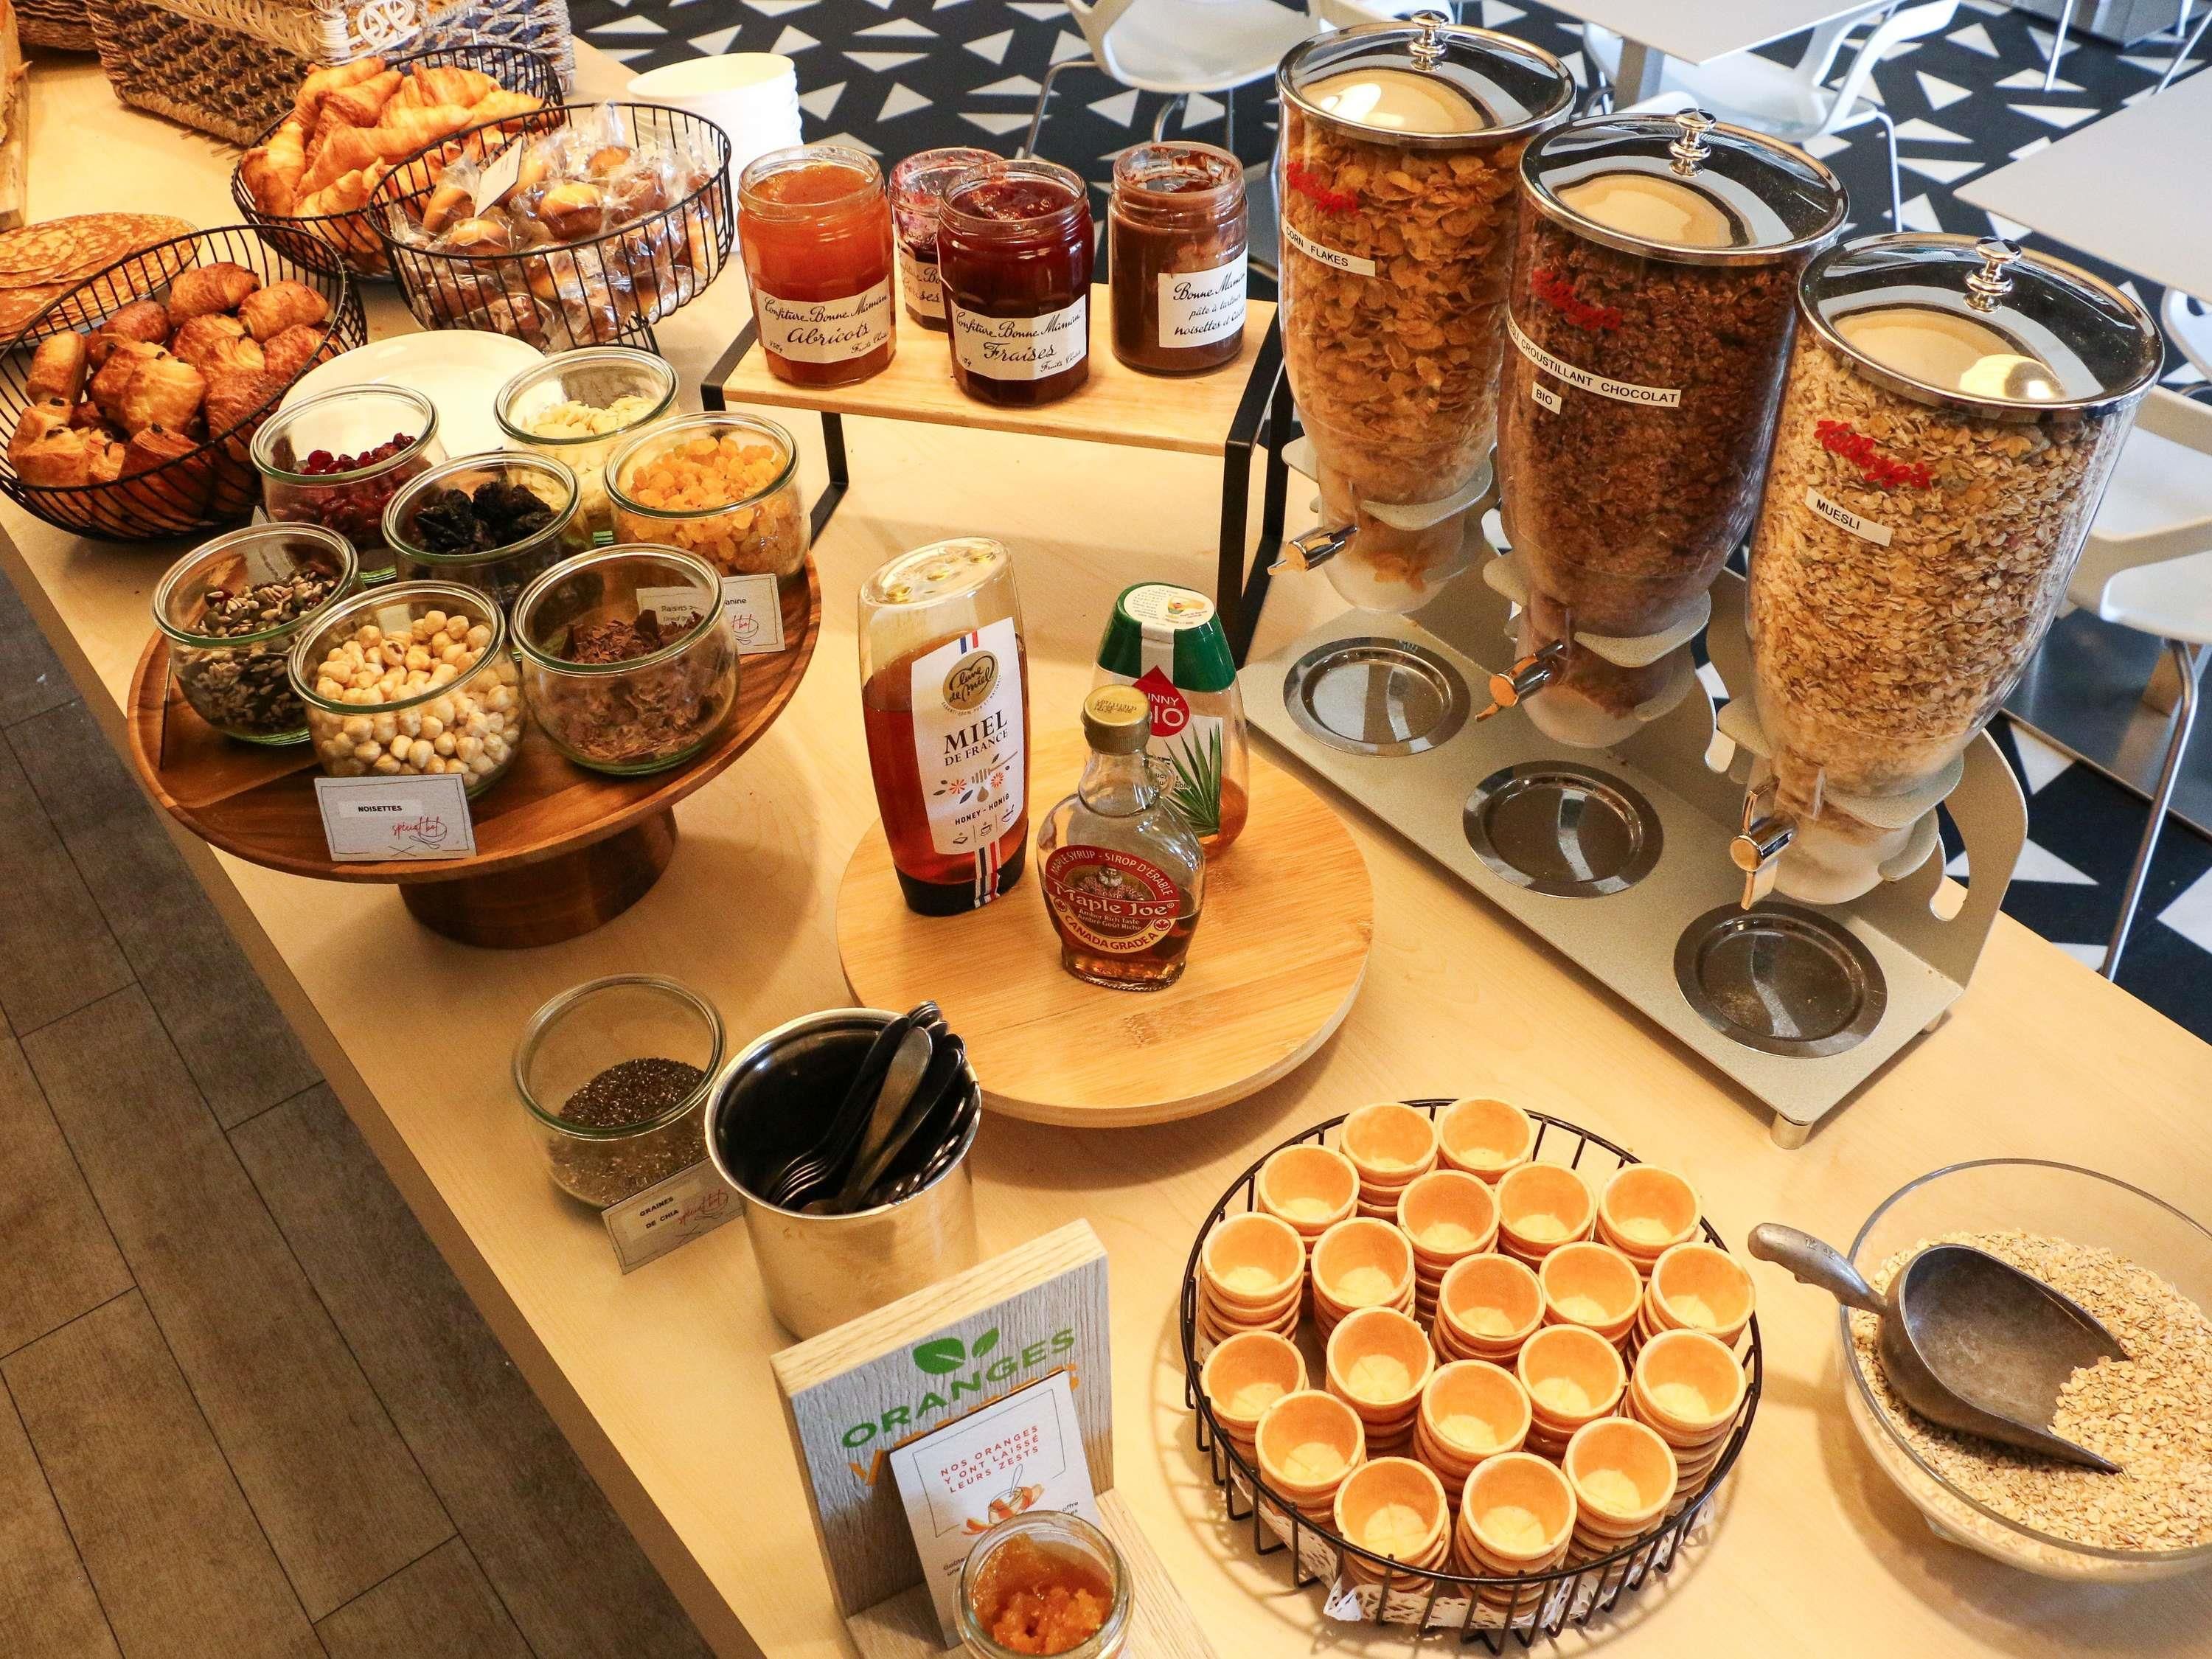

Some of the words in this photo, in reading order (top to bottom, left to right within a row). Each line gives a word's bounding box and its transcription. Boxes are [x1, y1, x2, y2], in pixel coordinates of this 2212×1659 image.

[1286, 226, 1304, 248] CORN
[1310, 246, 1349, 267] FLAKES
[1174, 282, 1214, 301] Bonne
[765, 296, 808, 321] Confiture
[810, 305, 849, 323] Bonne
[851, 295, 888, 318] Maman
[956, 310, 997, 338] Confiture
[998, 321, 1040, 338] Bonne
[1041, 311, 1081, 335] Maman
[1189, 307, 1210, 320] pâte
[1175, 320, 1221, 335] noisettes
[984, 341, 1057, 362] Fraises
[1521, 339, 1593, 386] CROUSTILLANT
[1601, 382, 1677, 403] CHOCOLAT
[1536, 389, 1553, 405] BIO
[1816, 499, 1860, 530] MUESLI
[1148, 693, 1179, 705] NNY
[943, 709, 1007, 754] MIEL
[1150, 706, 1184, 726] IO
[945, 752, 962, 766] DE
[966, 728, 1008, 759] FRANCE
[955, 810, 981, 825] HONEY
[990, 793, 1009, 811] HONIG
[1051, 853, 1069, 876] MAPLE
[1068, 850, 1096, 863] SYRUP
[1105, 852, 1137, 867] SIROP
[1137, 863, 1173, 897] D'ÉRABLE
[1054, 882, 1121, 914] Maple
[1079, 908, 1103, 920] Amber
[1105, 912, 1120, 924] Rich
[1065, 915, 1109, 948] CANADA
[1110, 936, 1150, 950] GRADE
[1149, 932, 1159, 940] A
[639, 1196, 674, 1217] GRAINES
[645, 1220, 656, 1229] DE
[660, 1208, 679, 1222] CHIA
[841, 1327, 1075, 1448] ORANGES
[941, 1460, 967, 1477] NOS
[975, 1425, 1038, 1460] ORANGES
[960, 1461, 985, 1478] ONT
[992, 1434, 1038, 1462] LAISSÉ
[950, 1469, 991, 1493] LEURS
[998, 1447, 1038, 1470] ZESTS
